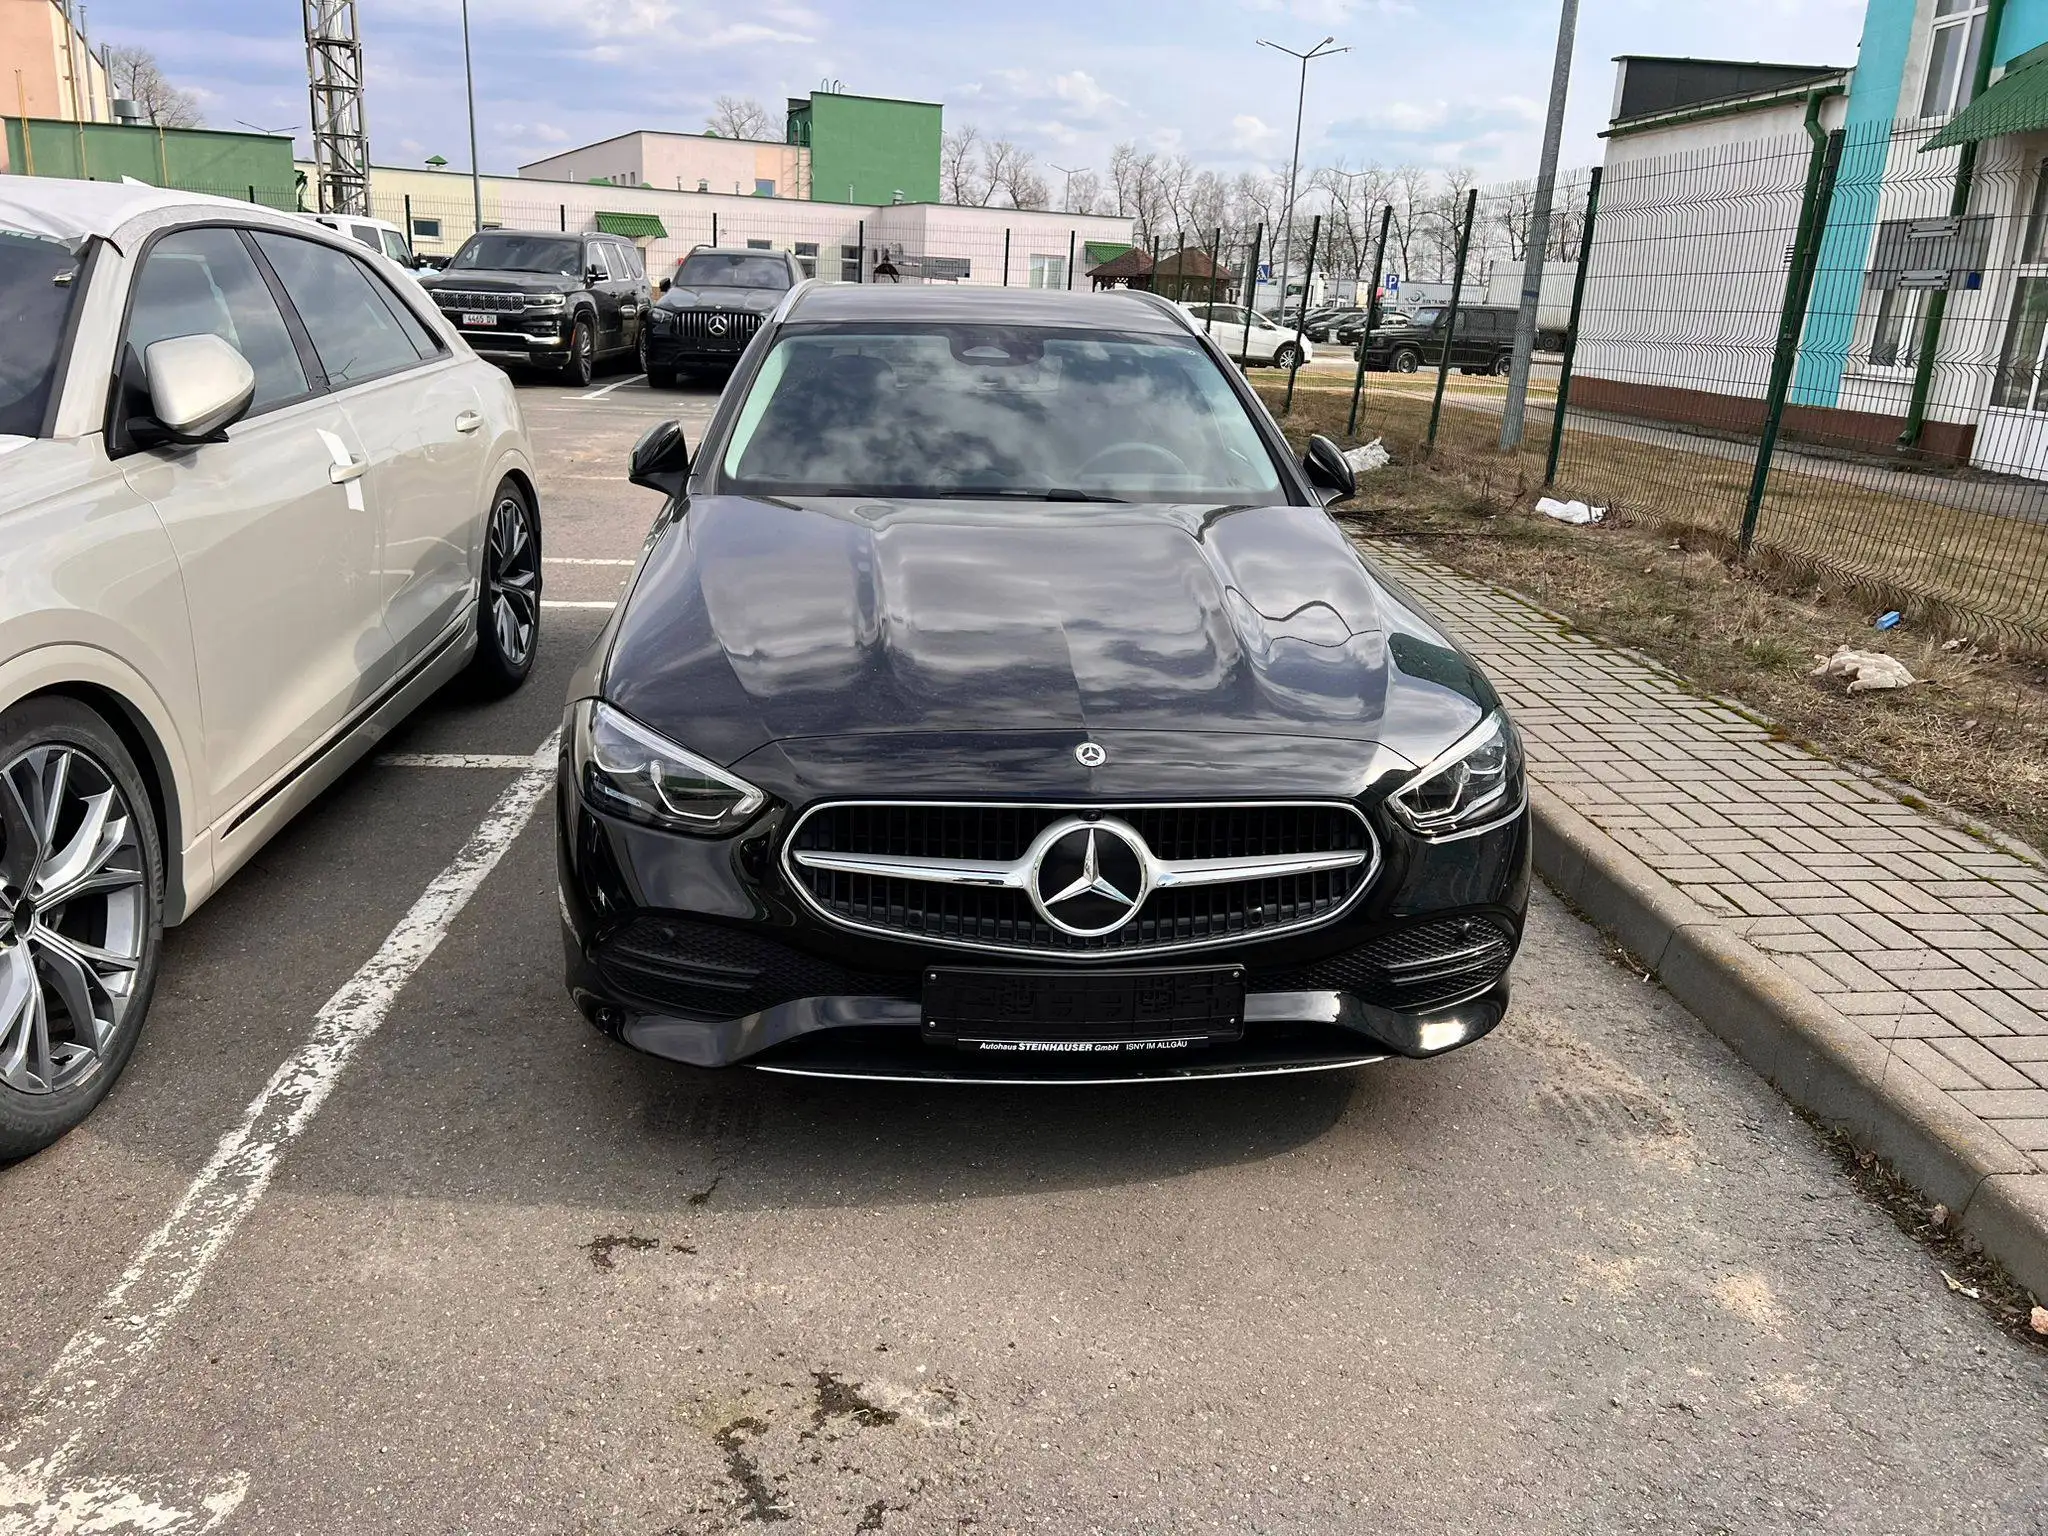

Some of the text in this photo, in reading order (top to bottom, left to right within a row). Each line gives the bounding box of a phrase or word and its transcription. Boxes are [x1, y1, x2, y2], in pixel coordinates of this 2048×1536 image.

[1389, 276, 1398, 288] P
[979, 1042, 1018, 1051] Autohaus
[1018, 1042, 1093, 1052] STEINHAUSER
[1094, 1043, 1120, 1052] GmbH
[1125, 1042, 1145, 1051] ISNY
[1146, 1042, 1156, 1050] IM
